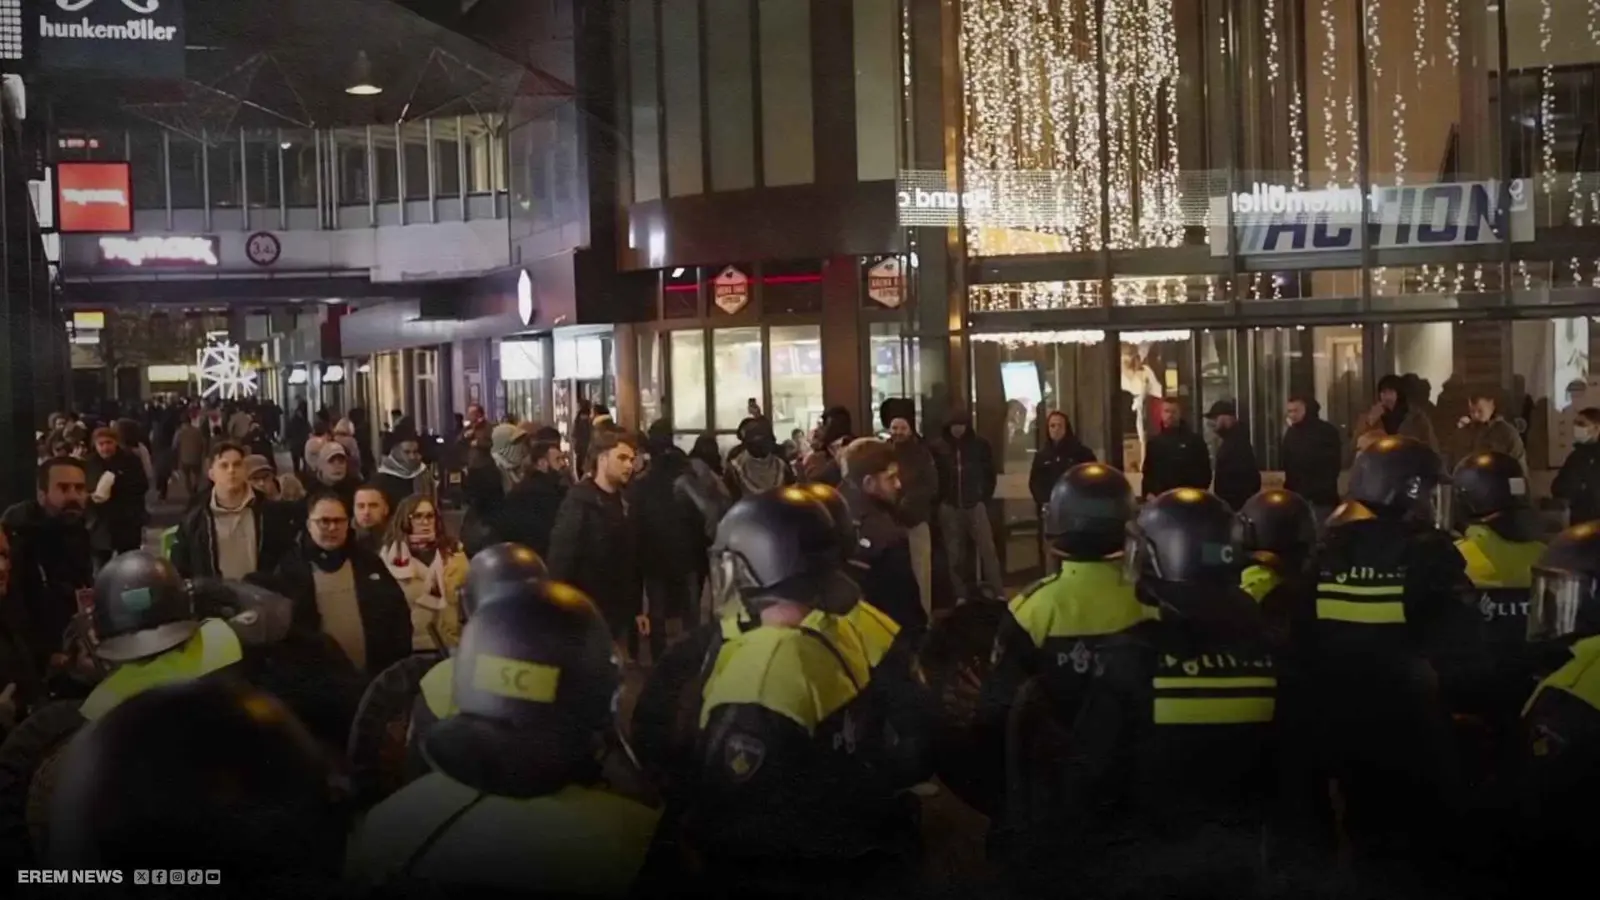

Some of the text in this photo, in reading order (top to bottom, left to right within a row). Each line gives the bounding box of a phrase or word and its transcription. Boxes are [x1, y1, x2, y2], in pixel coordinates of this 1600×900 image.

[39, 15, 177, 41] hunkemöller
[1262, 184, 1505, 250] ACTION
[501, 667, 531, 692] SC
